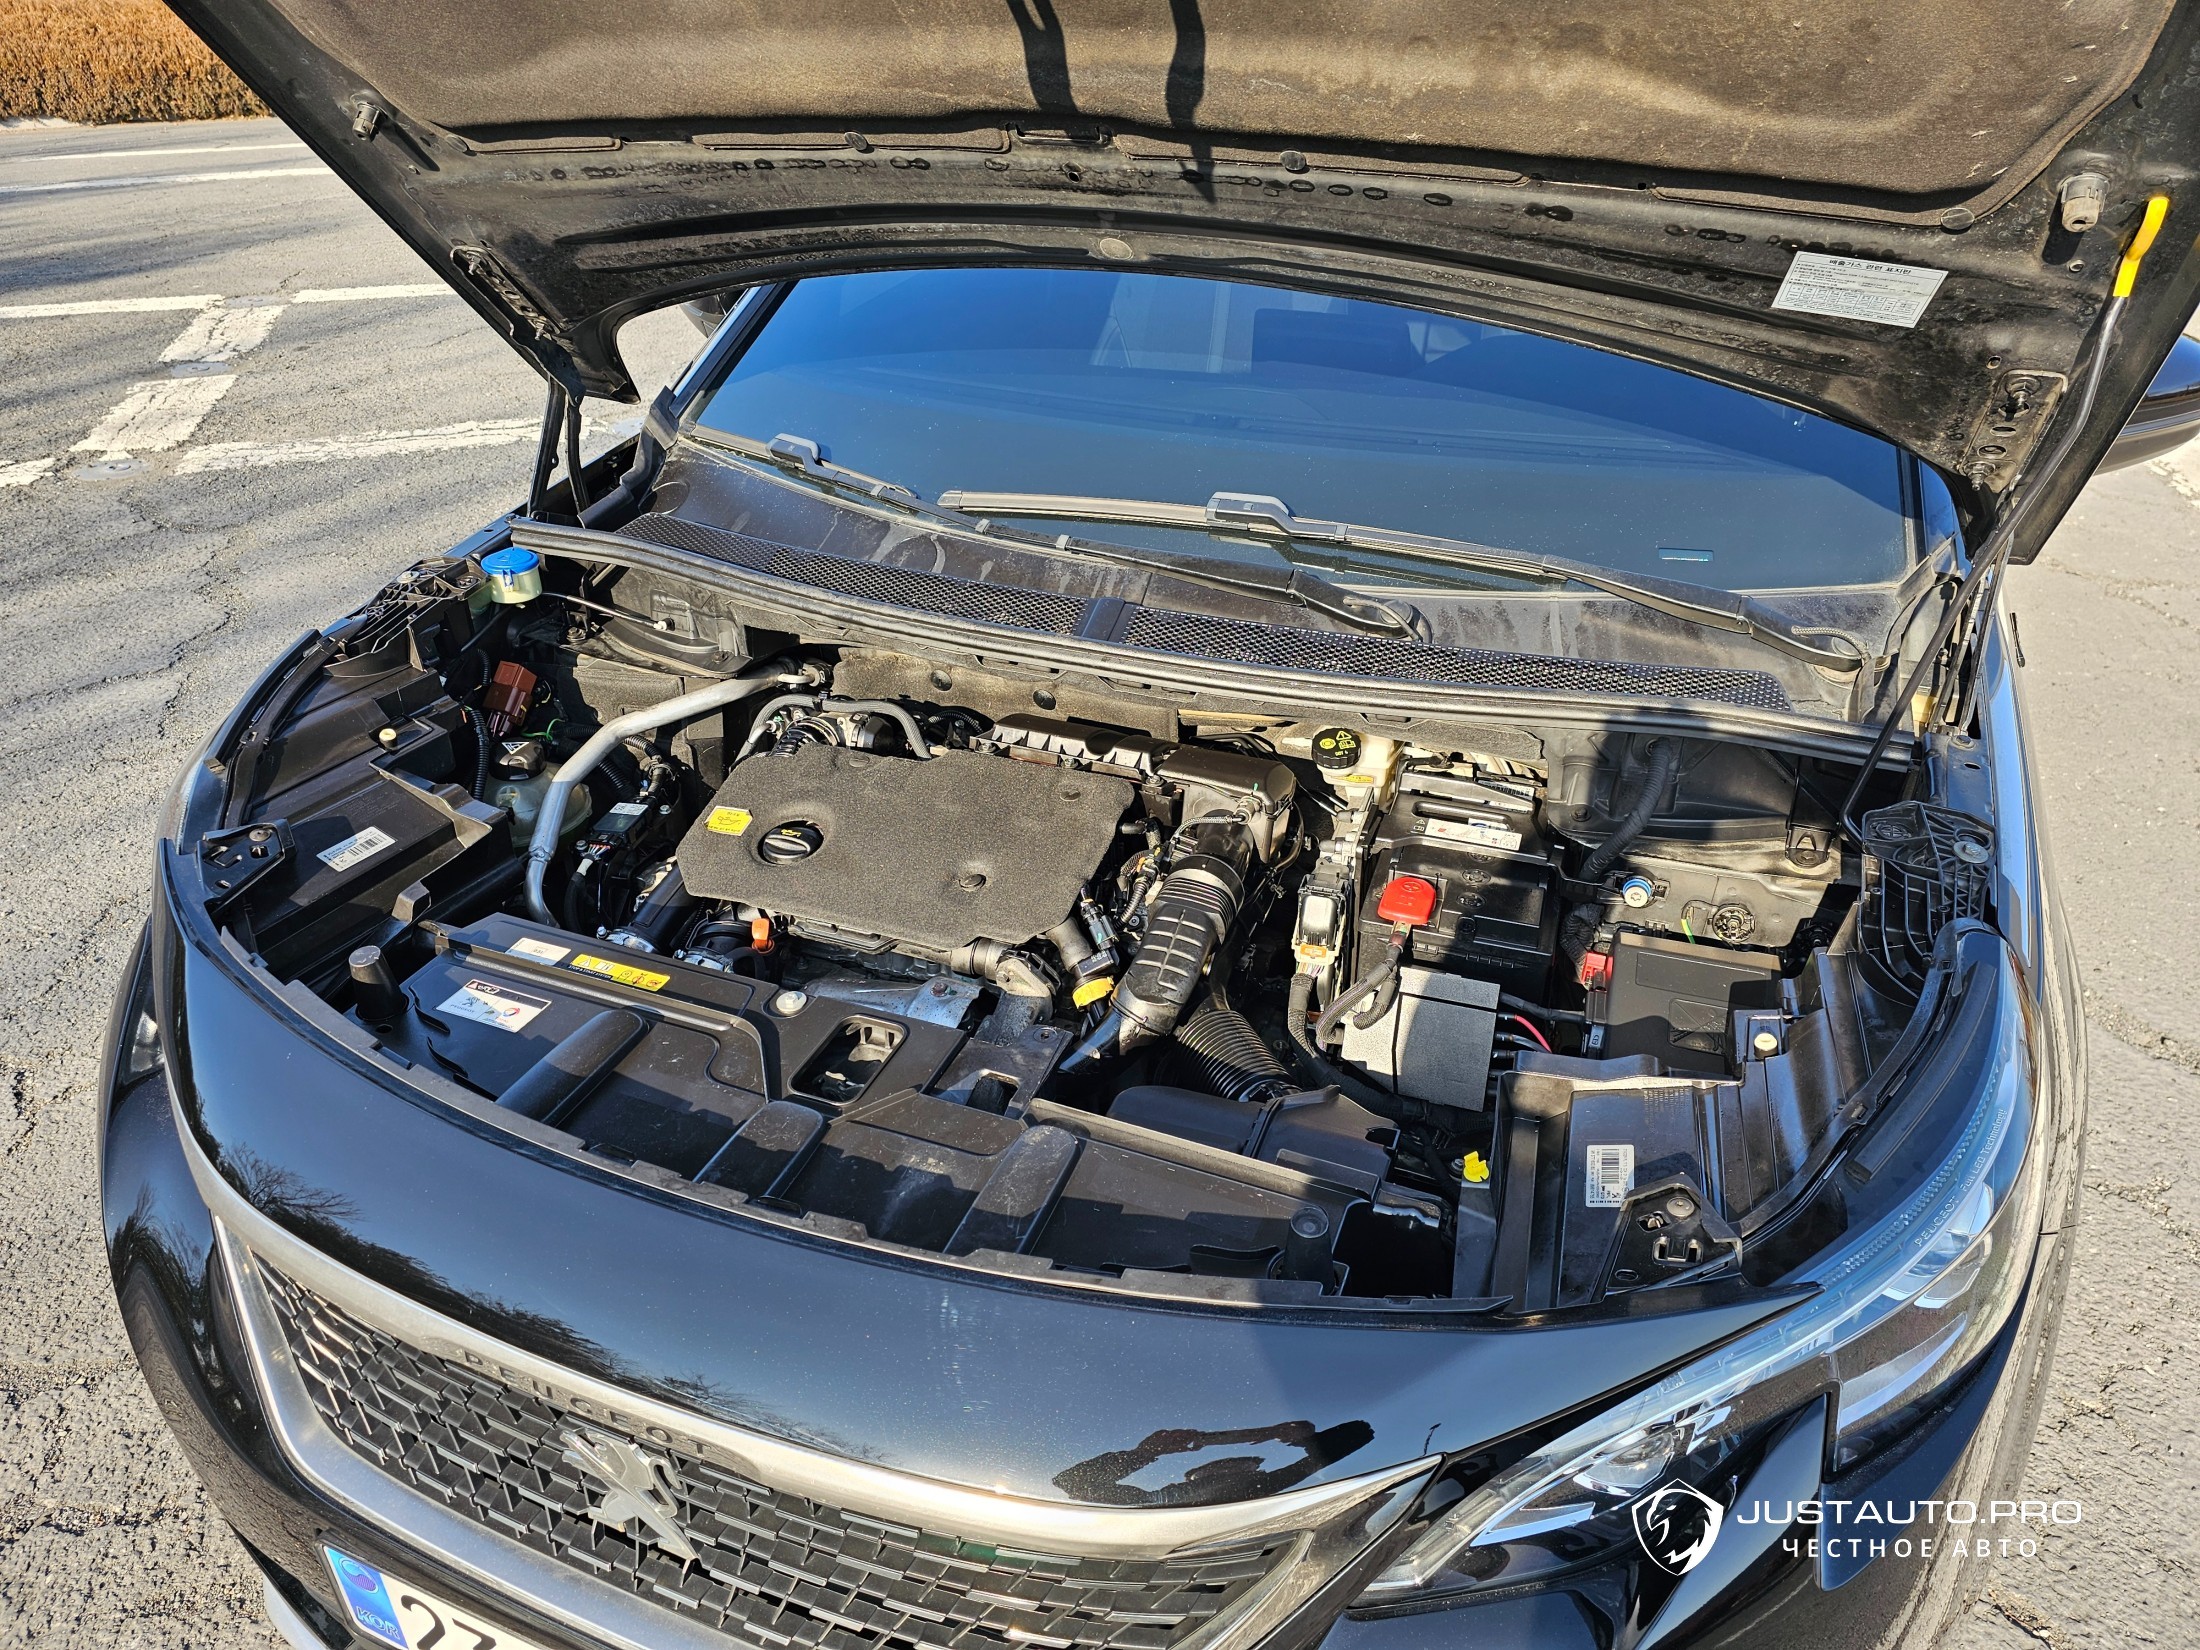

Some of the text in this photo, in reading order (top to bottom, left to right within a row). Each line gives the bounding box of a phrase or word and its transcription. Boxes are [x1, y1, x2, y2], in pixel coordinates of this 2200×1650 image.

[1914, 1195, 1960, 1247] PEUGEOT
[1973, 1155, 1986, 1174] LED
[1982, 1109, 2008, 1155] Technology
[465, 1350, 706, 1457] PEUGEOT
[355, 1604, 400, 1640] KOR
